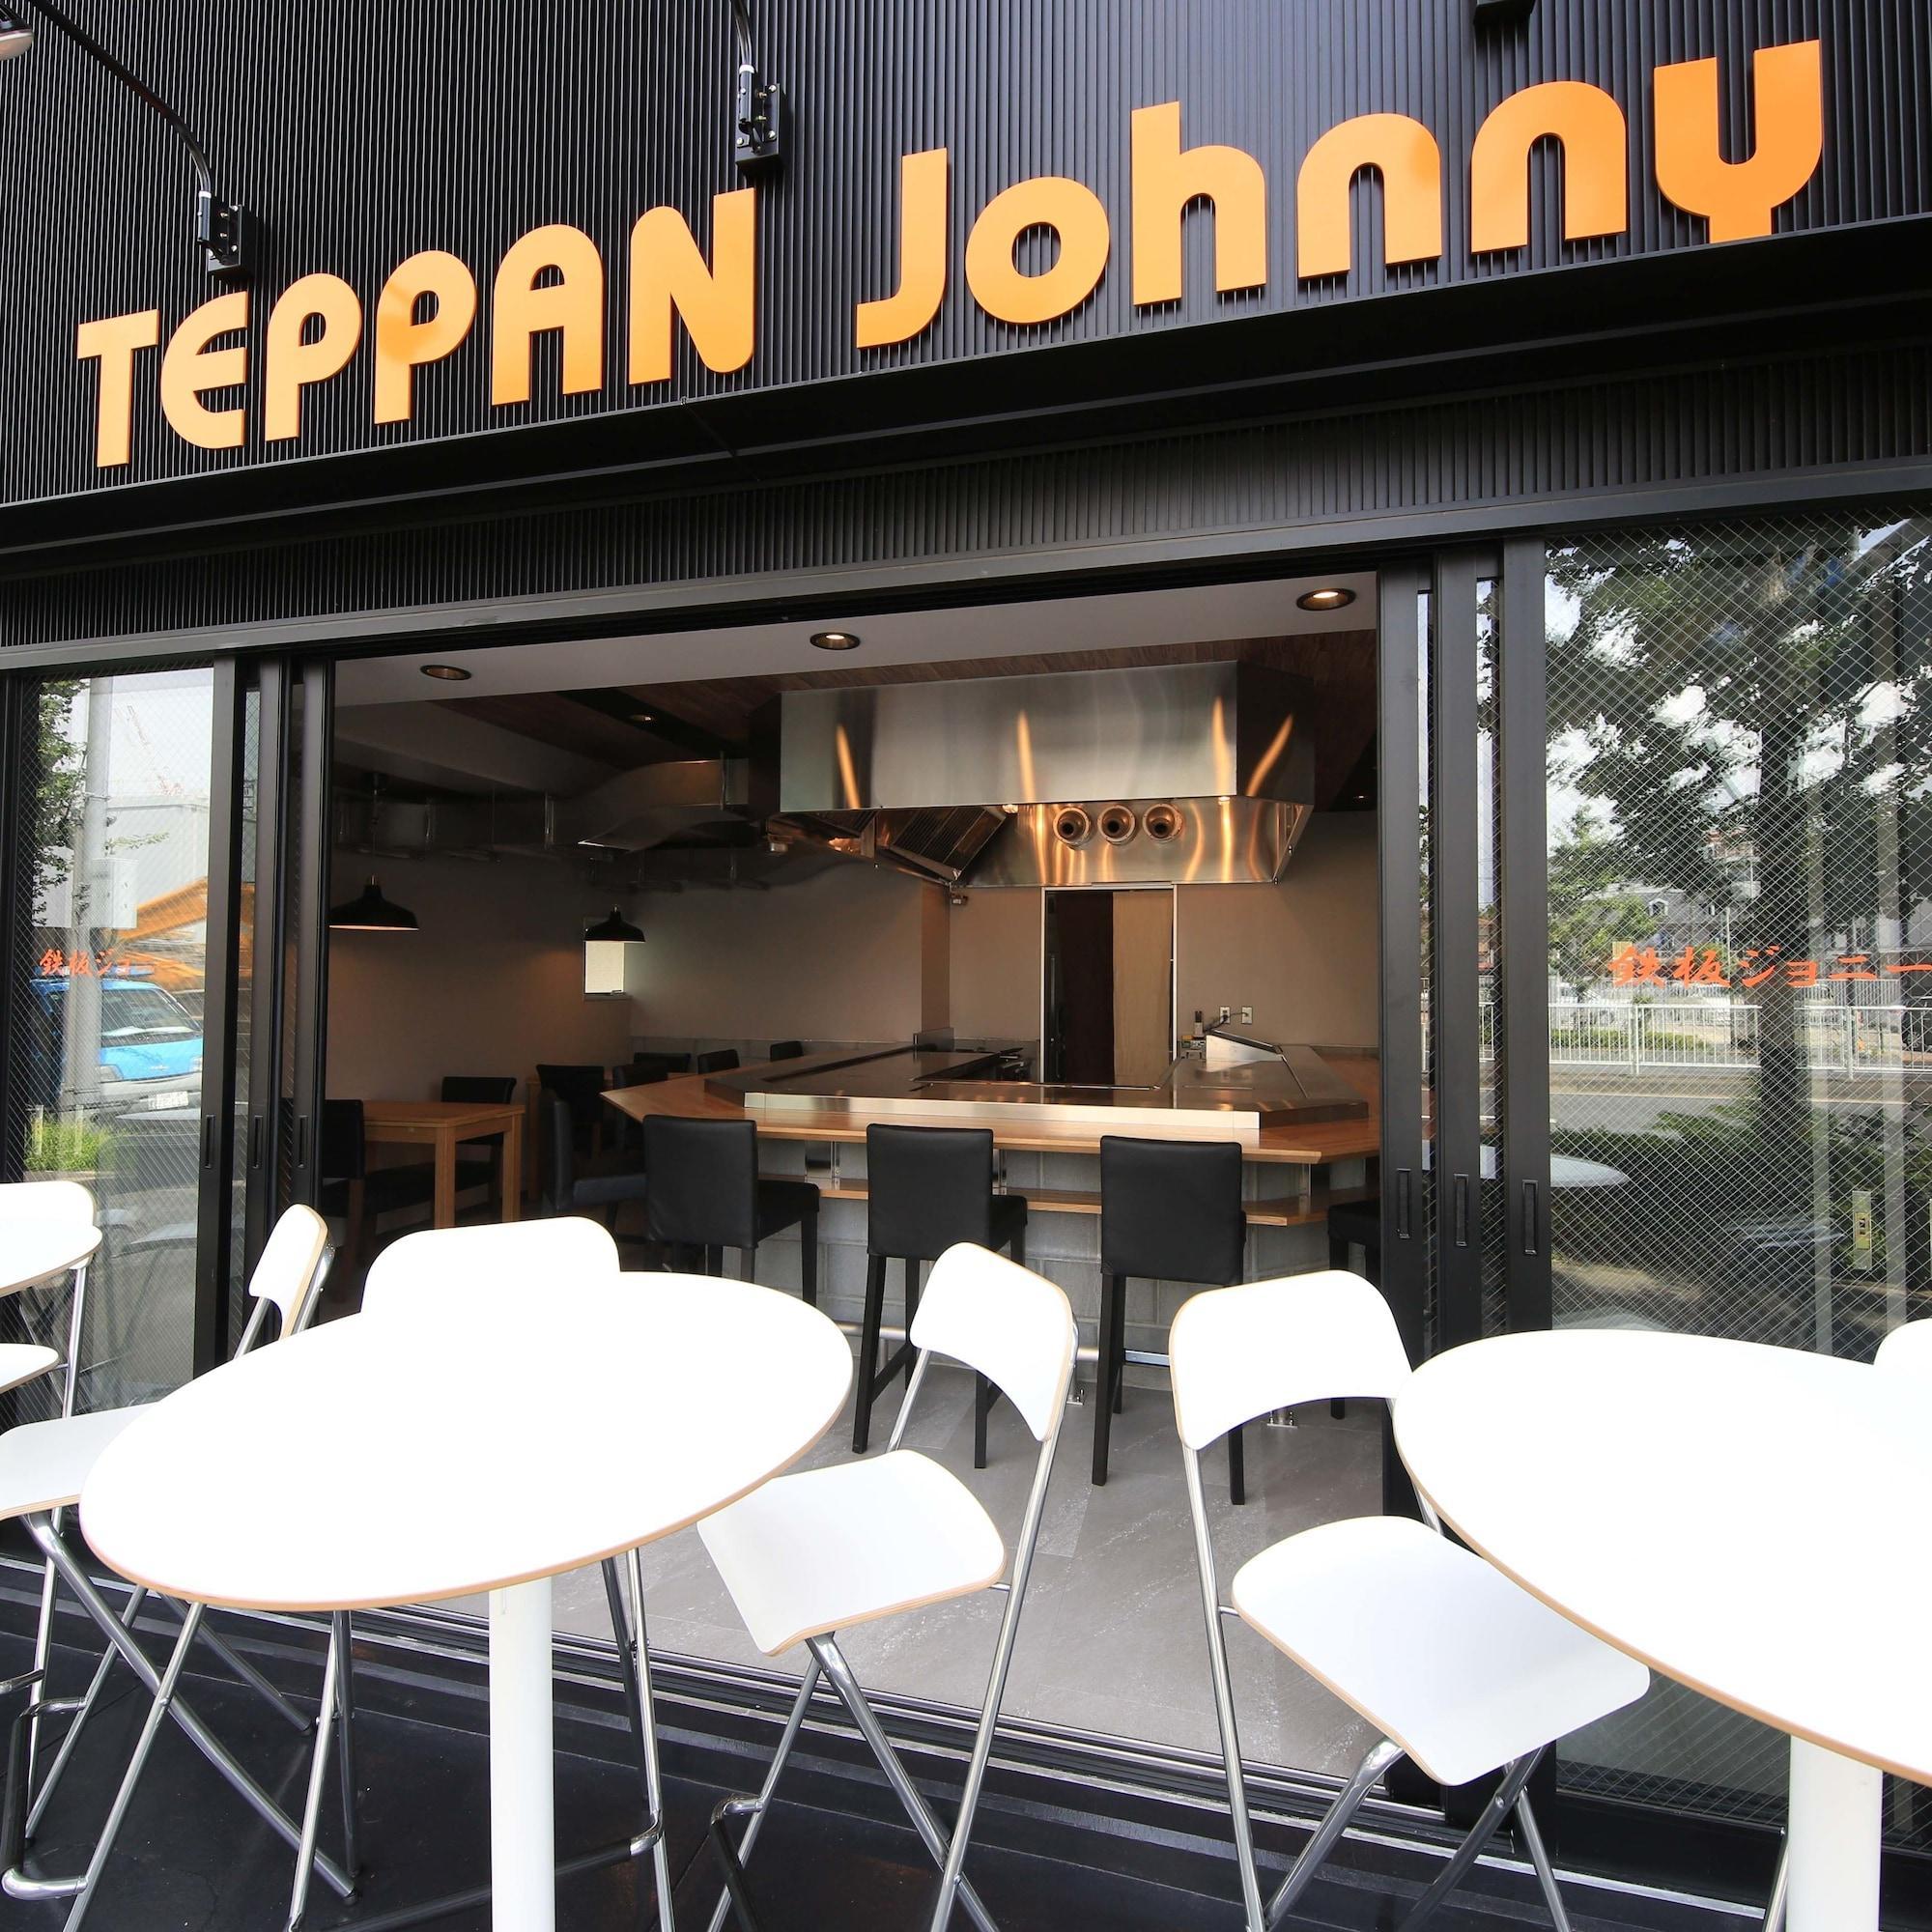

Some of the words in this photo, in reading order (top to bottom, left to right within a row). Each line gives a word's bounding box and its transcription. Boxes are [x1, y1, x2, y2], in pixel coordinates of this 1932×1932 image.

[76, 186, 756, 469] TEPPAN
[855, 39, 1824, 350] Johnny
[1607, 945, 1932, 988] 鉄板ジョニー
